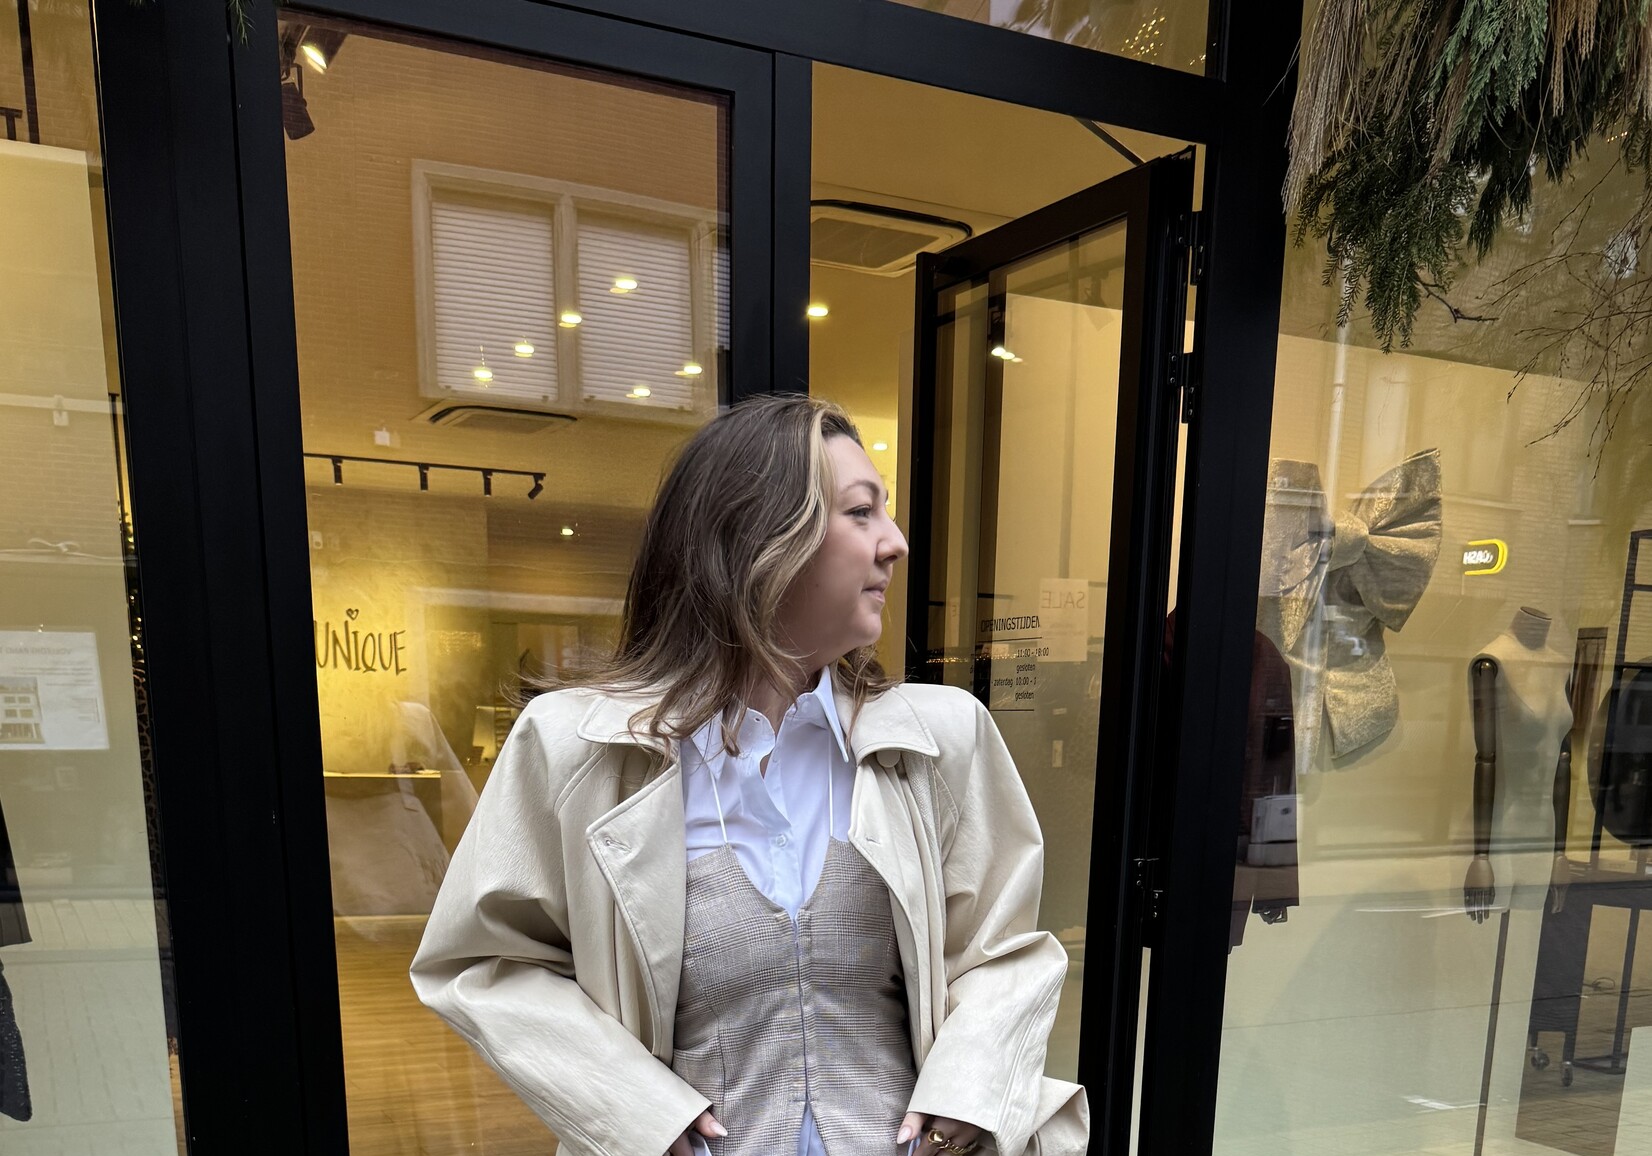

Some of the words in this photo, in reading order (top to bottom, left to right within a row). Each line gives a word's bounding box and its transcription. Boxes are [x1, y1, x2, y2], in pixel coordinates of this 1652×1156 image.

[981, 615, 1041, 632] OPENINGSTIJDEN
[314, 620, 407, 676] UNIQUE
[1016, 663, 1036, 674] gesloten
[1015, 691, 1034, 701] gesloten
